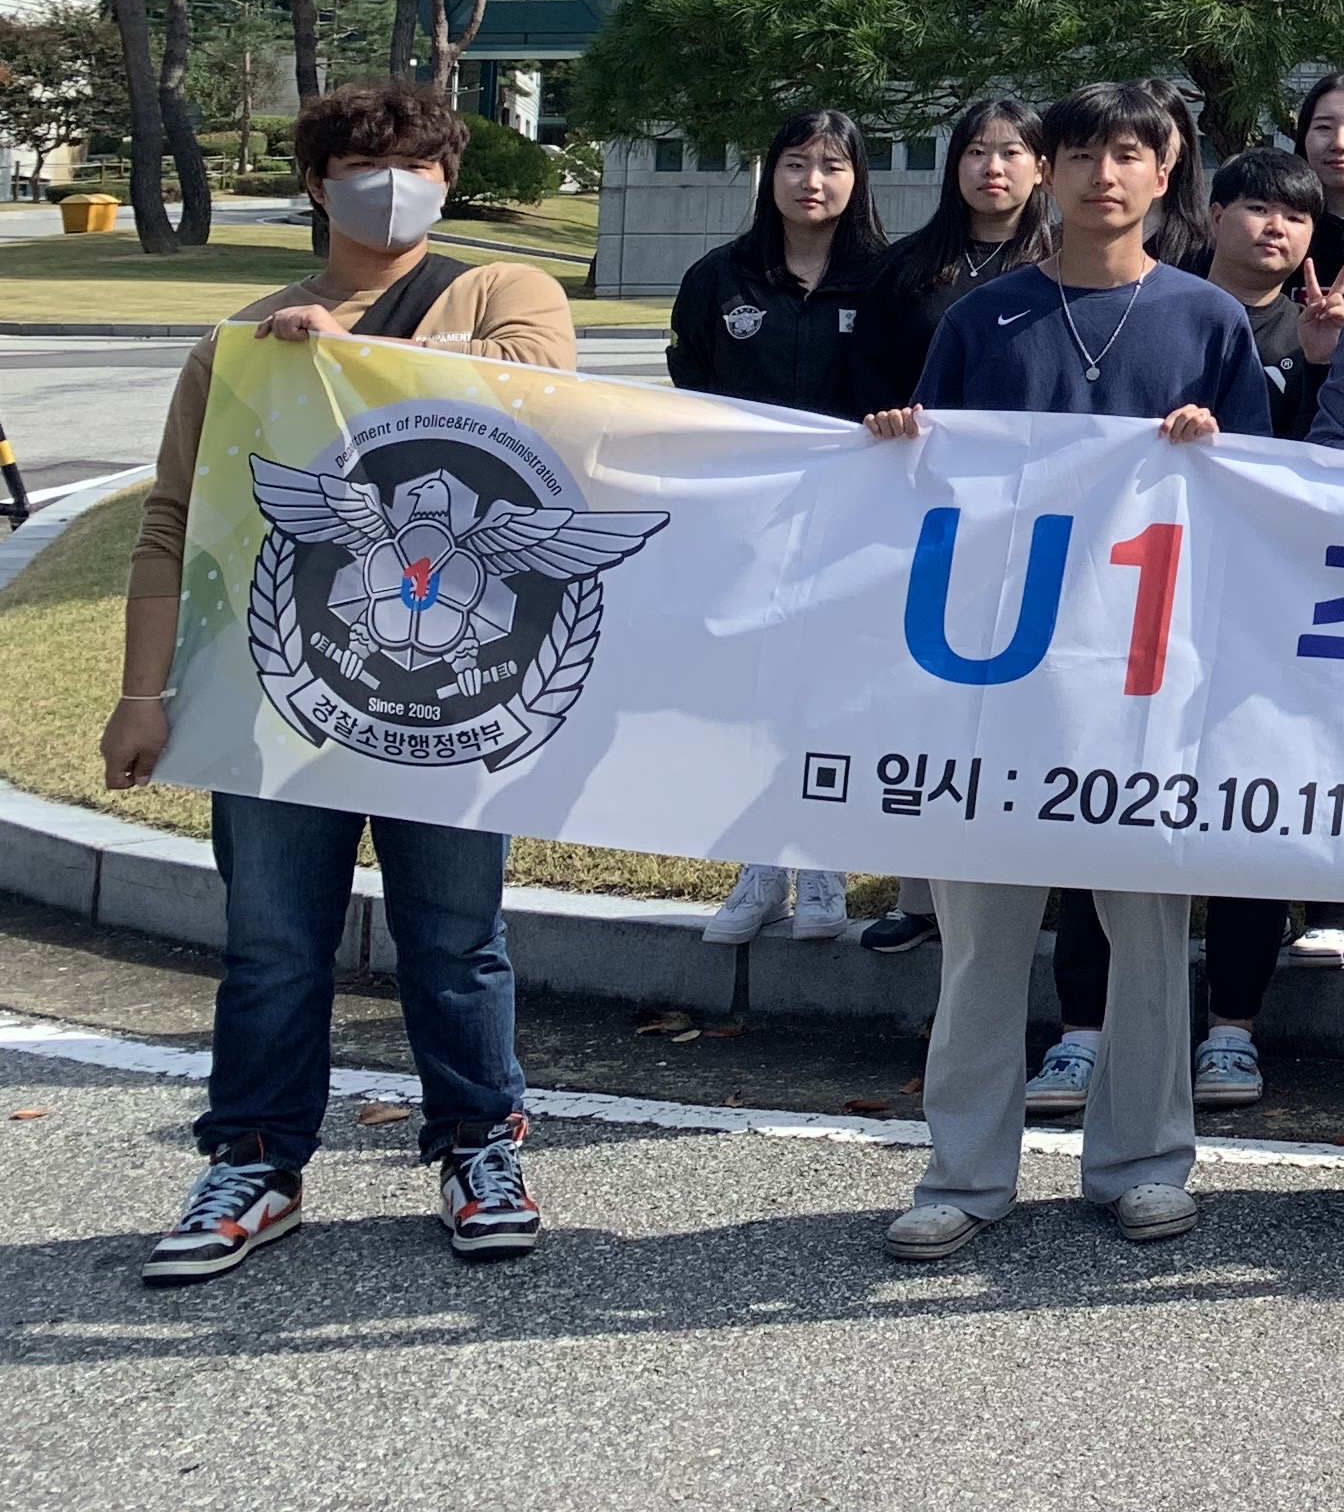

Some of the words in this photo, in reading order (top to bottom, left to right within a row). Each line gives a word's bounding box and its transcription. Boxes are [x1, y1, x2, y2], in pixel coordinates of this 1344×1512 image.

[396, 416, 410, 433] of
[414, 414, 488, 436] Police&Fire
[488, 426, 563, 497] Administration
[904, 506, 1184, 697] U1
[311, 692, 505, 759] 경찰소방행정학부
[367, 696, 404, 717] Since
[408, 702, 442, 722] 2003
[875, 751, 983, 822] 일시
